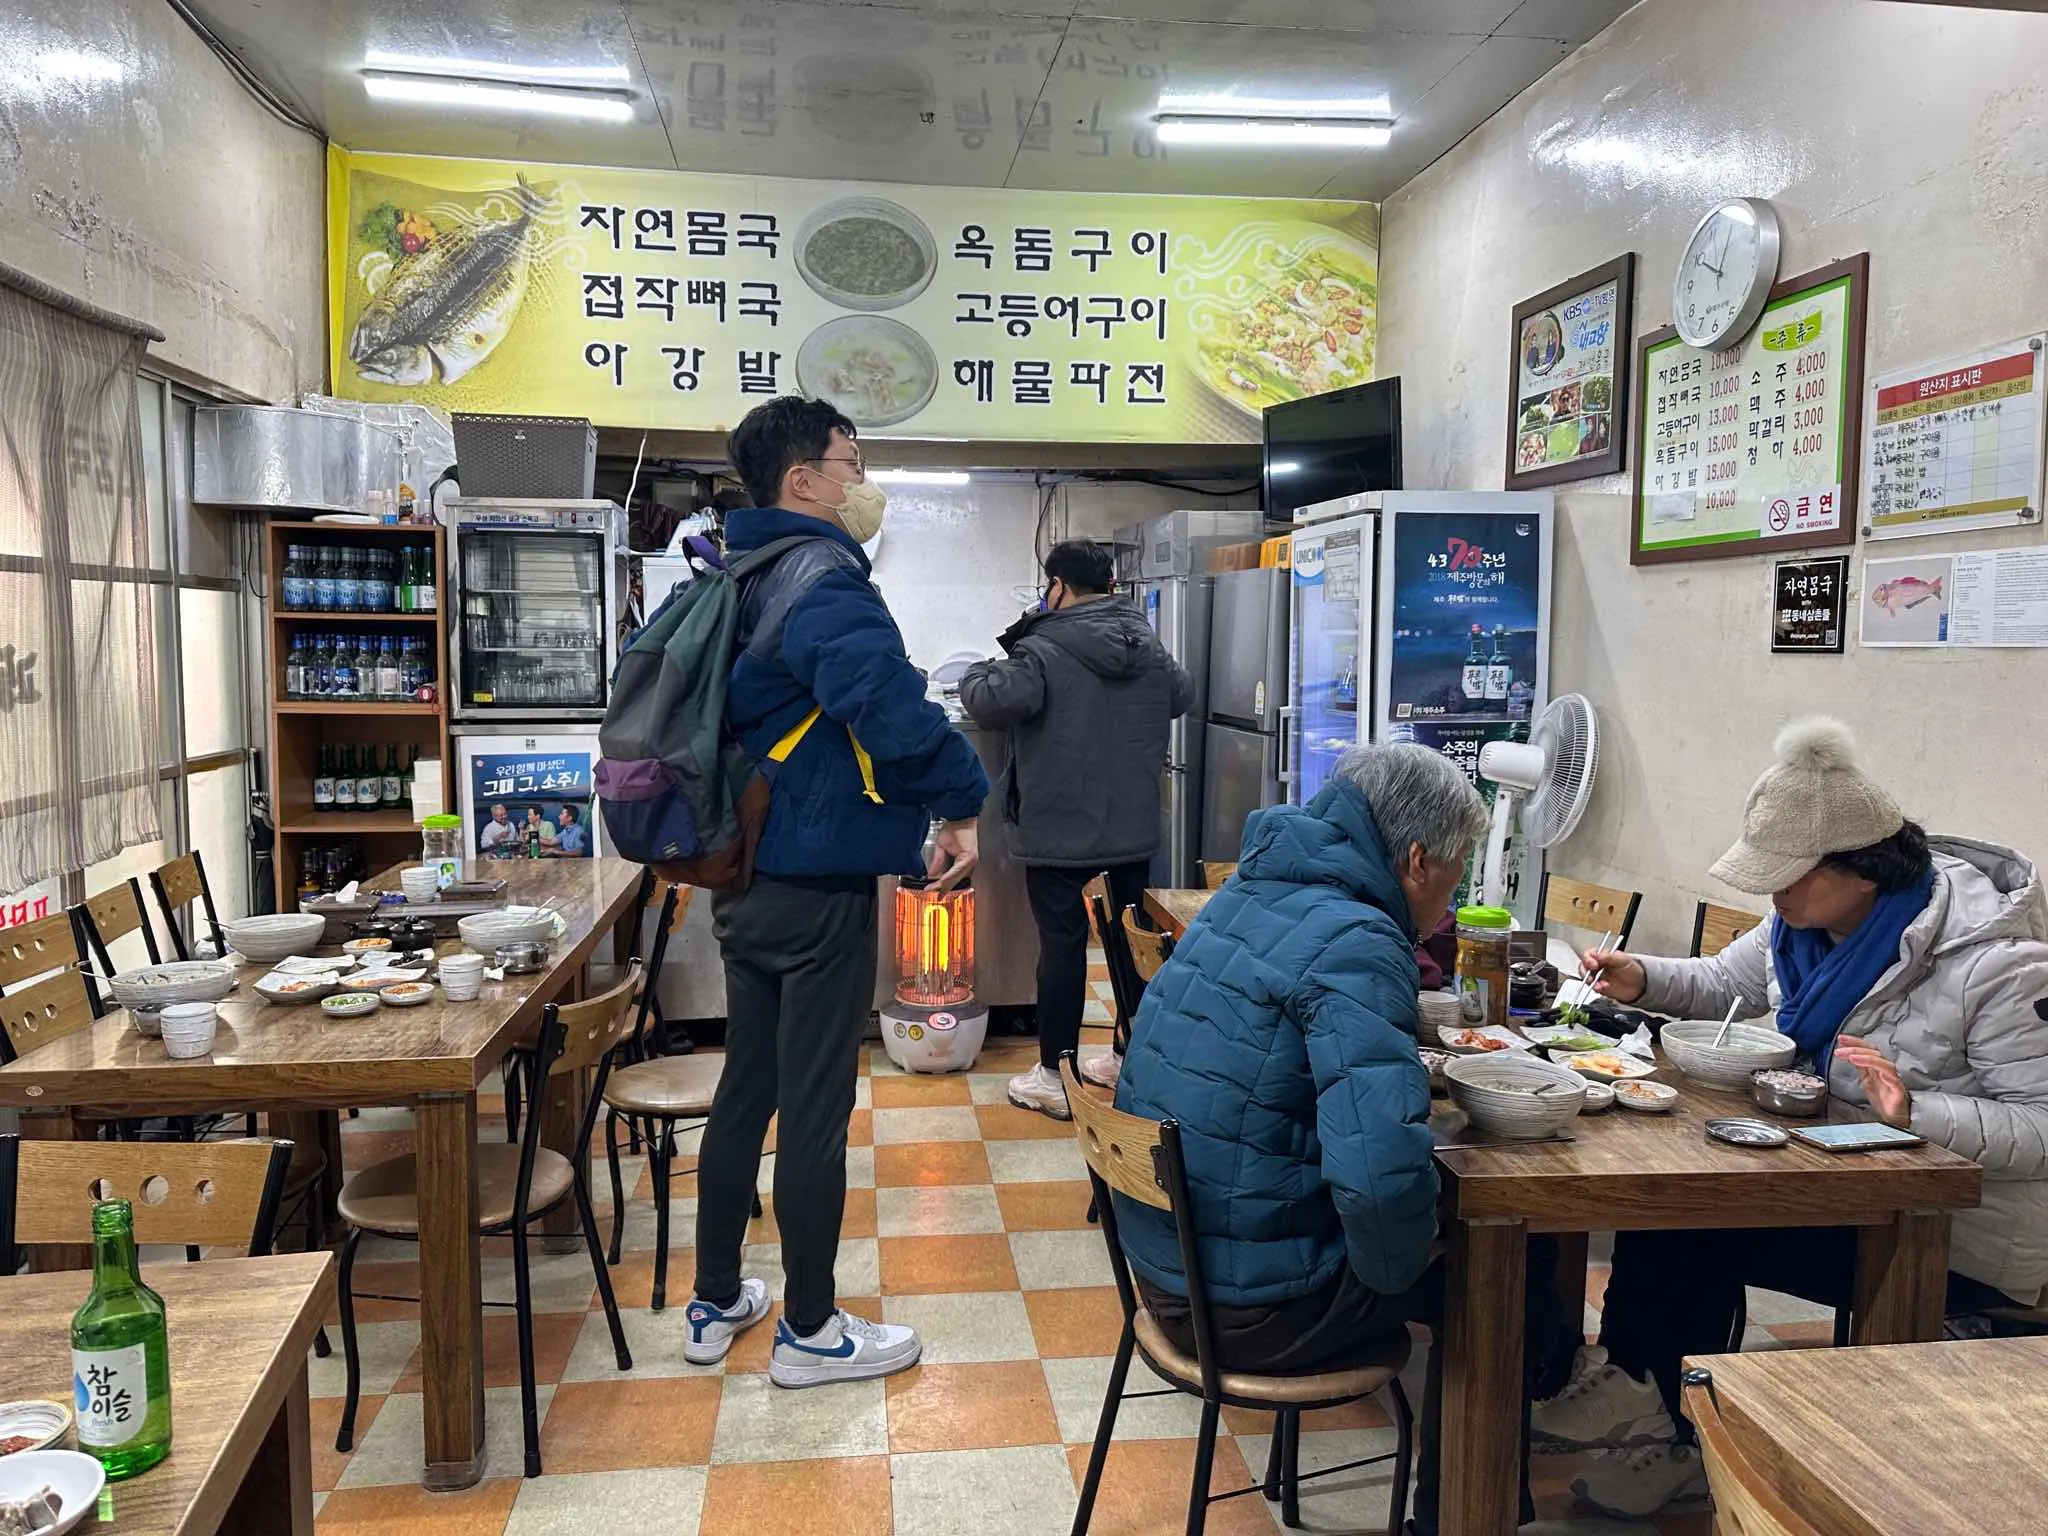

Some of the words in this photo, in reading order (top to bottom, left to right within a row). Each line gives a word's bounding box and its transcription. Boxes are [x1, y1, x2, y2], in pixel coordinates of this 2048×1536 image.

[580, 205, 780, 259] 자연몸국
[954, 225, 1167, 274] 옥돔구이
[582, 273, 781, 326] 접작뼈국
[1563, 302, 1582, 321] KBS
[955, 294, 1166, 339] 고등어구이
[584, 342, 781, 394] 아강발
[1711, 347, 1741, 371] 10,000
[1796, 351, 1826, 377] 4,000
[953, 360, 1165, 404] 해물파전
[1709, 375, 1740, 398] 10,000
[1795, 378, 1825, 403] 4,000
[1919, 376, 1949, 397] 원산지
[1950, 368, 1983, 389] 표시판
[1656, 412, 1700, 438] 고등어구이
[1708, 404, 1739, 426] 13,000
[1749, 414, 1785, 439] 막걸리
[1793, 406, 1824, 430] 3,000
[1656, 440, 1699, 465] 옥돔구이
[1792, 433, 1822, 457] 4,000
[1705, 489, 1736, 509] 10,000
[1796, 492, 1833, 518] 금연
[1806, 519, 1833, 529] SMOKING
[1441, 740, 1478, 756] 소주의
